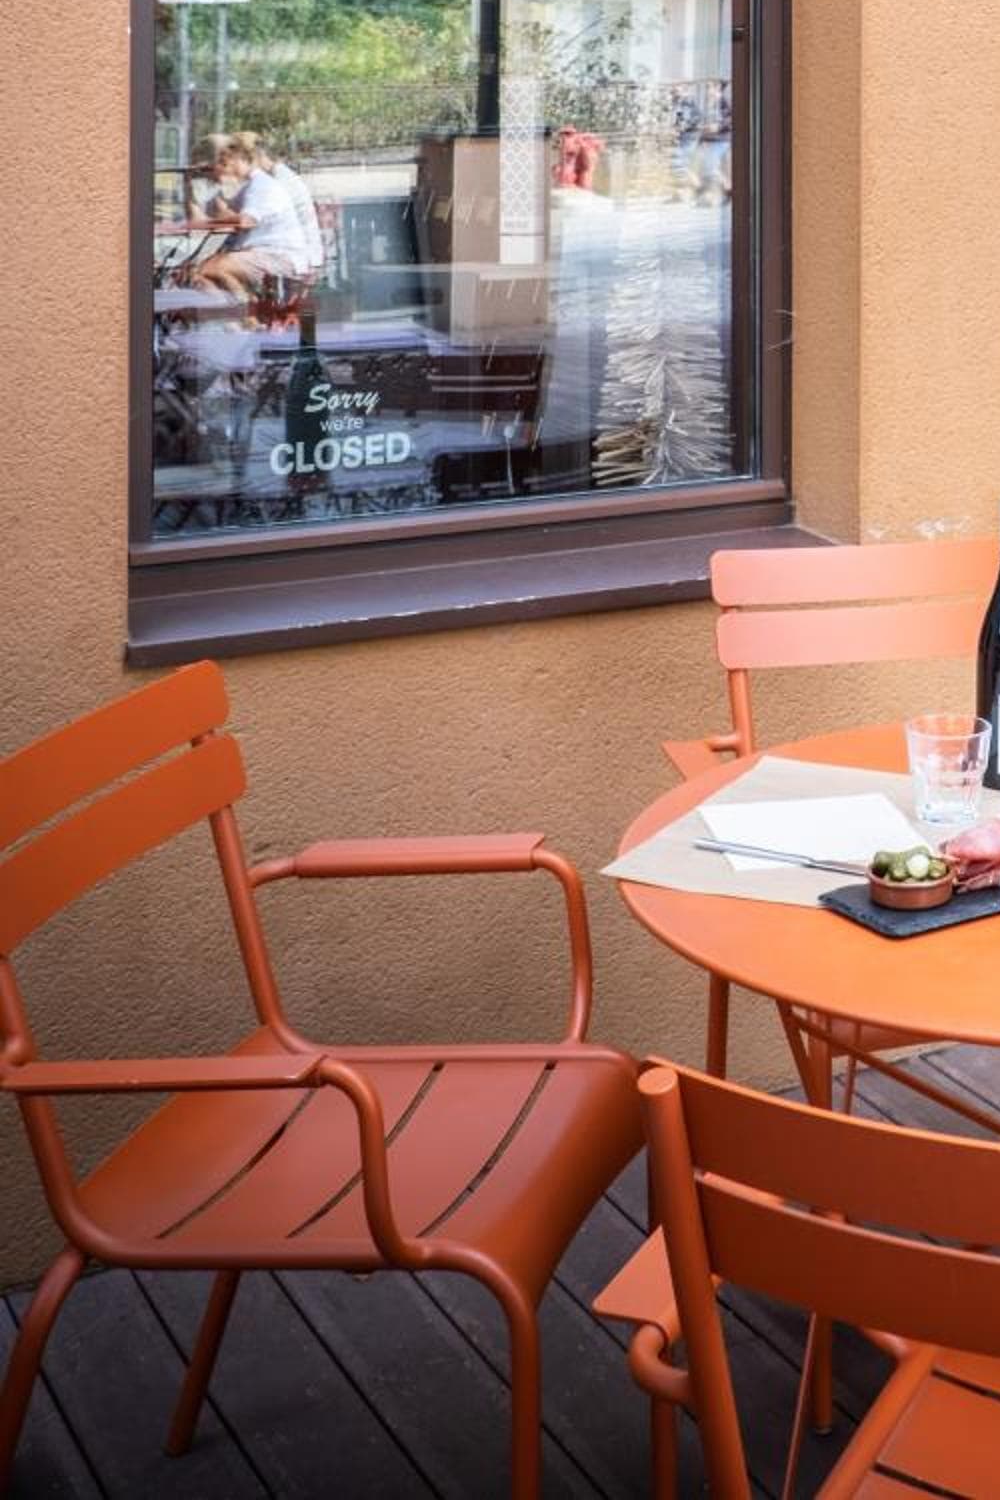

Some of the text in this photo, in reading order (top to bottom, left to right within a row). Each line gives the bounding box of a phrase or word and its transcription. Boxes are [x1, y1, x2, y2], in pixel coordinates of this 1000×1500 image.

[304, 383, 381, 415] Sorry
[320, 416, 364, 432] we're
[270, 431, 411, 475] CLOSED
